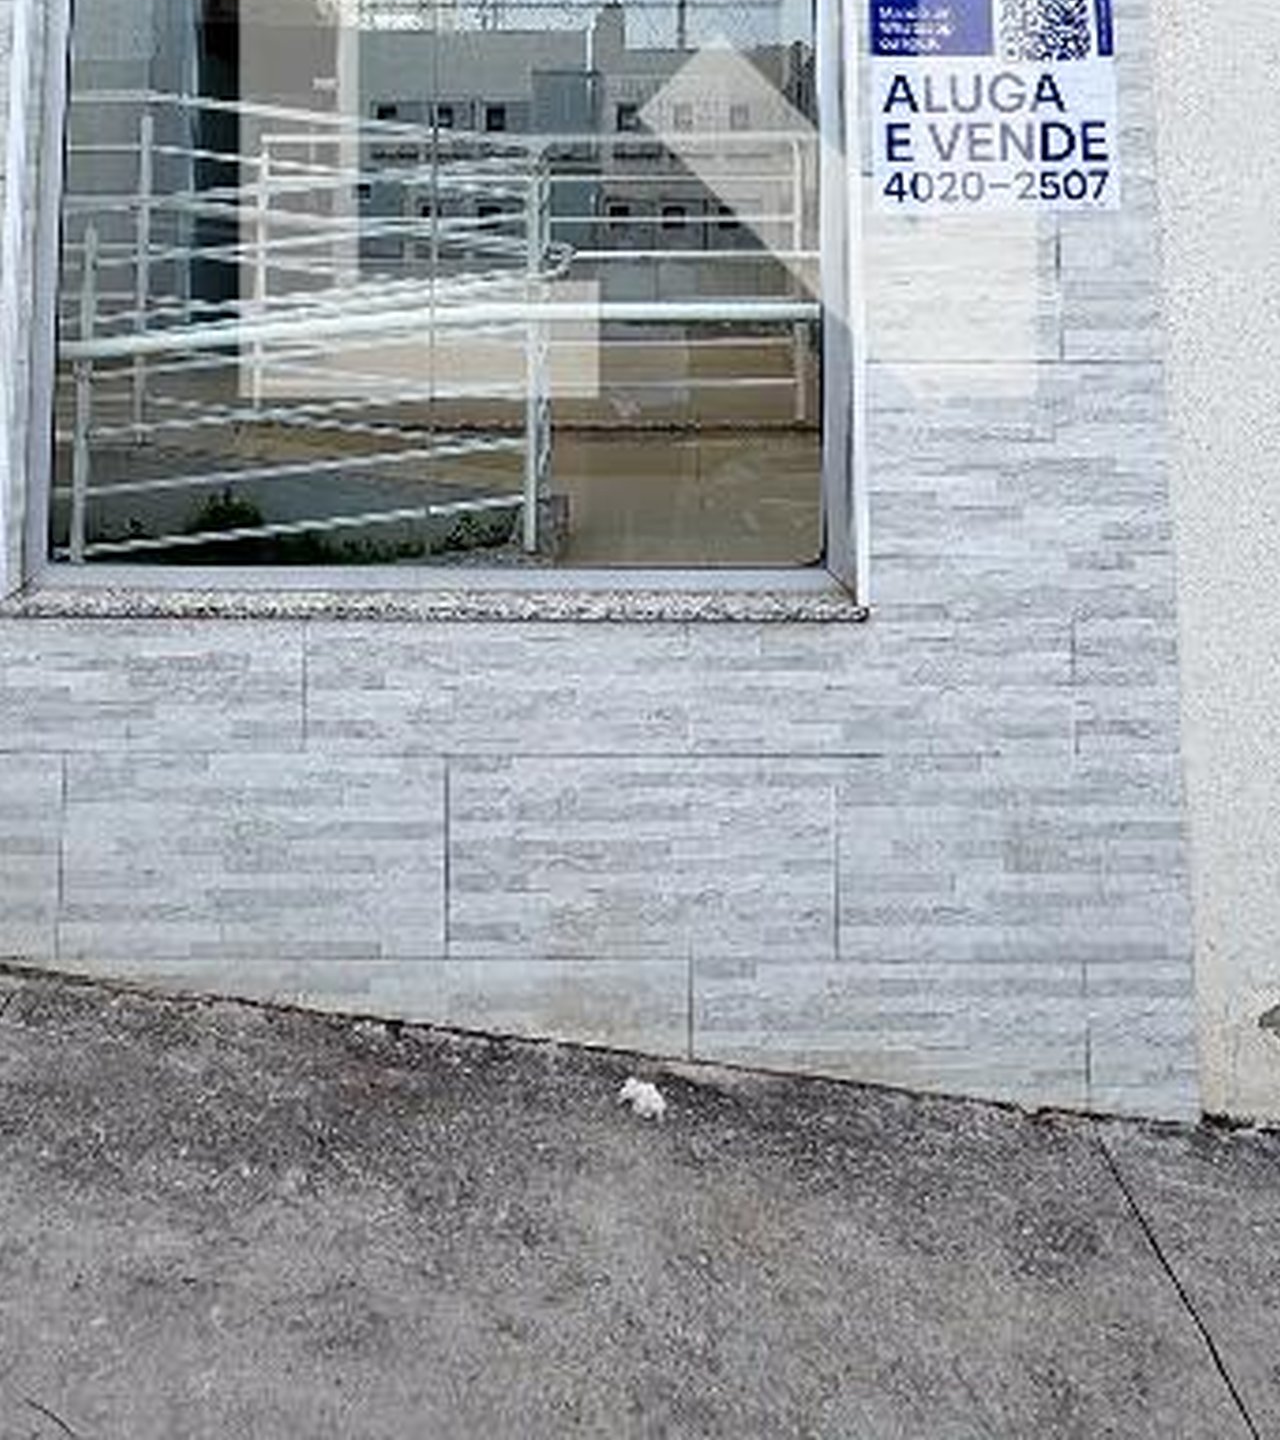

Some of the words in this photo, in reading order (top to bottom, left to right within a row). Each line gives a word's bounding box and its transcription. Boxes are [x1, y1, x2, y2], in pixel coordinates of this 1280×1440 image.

[882, 72, 1068, 113] ALUGA
[886, 122, 915, 162] E
[927, 121, 1110, 162] VENDE
[883, 169, 1110, 202] 4020-2507
